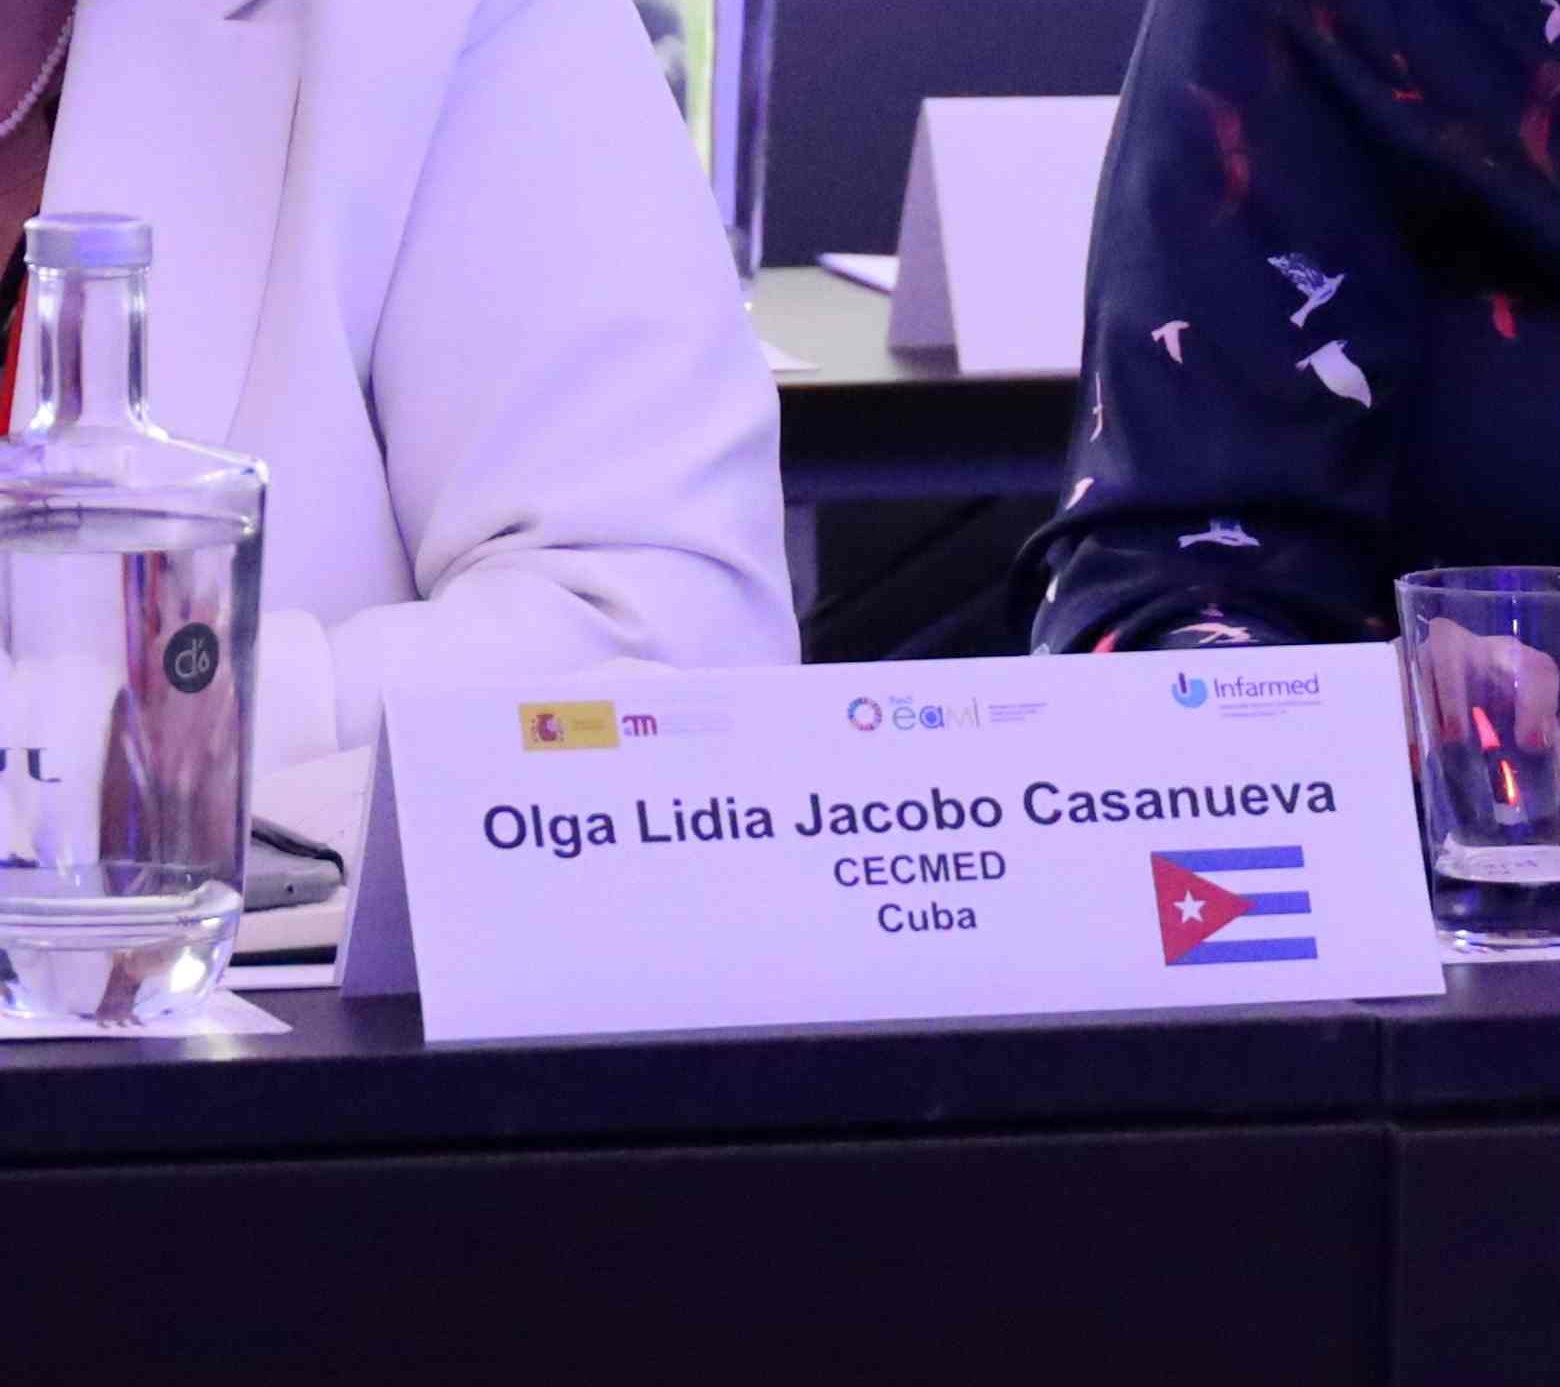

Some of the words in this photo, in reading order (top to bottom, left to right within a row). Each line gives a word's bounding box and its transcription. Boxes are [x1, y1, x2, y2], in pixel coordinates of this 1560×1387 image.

[1213, 673, 1321, 699] Infarmed
[483, 804, 617, 859] Olga
[636, 796, 775, 844] Lidia
[794, 787, 1003, 837] Jacobo
[1023, 781, 1337, 826] Casanueva
[833, 850, 1006, 888] CECMED
[877, 901, 977, 933] Cuba
